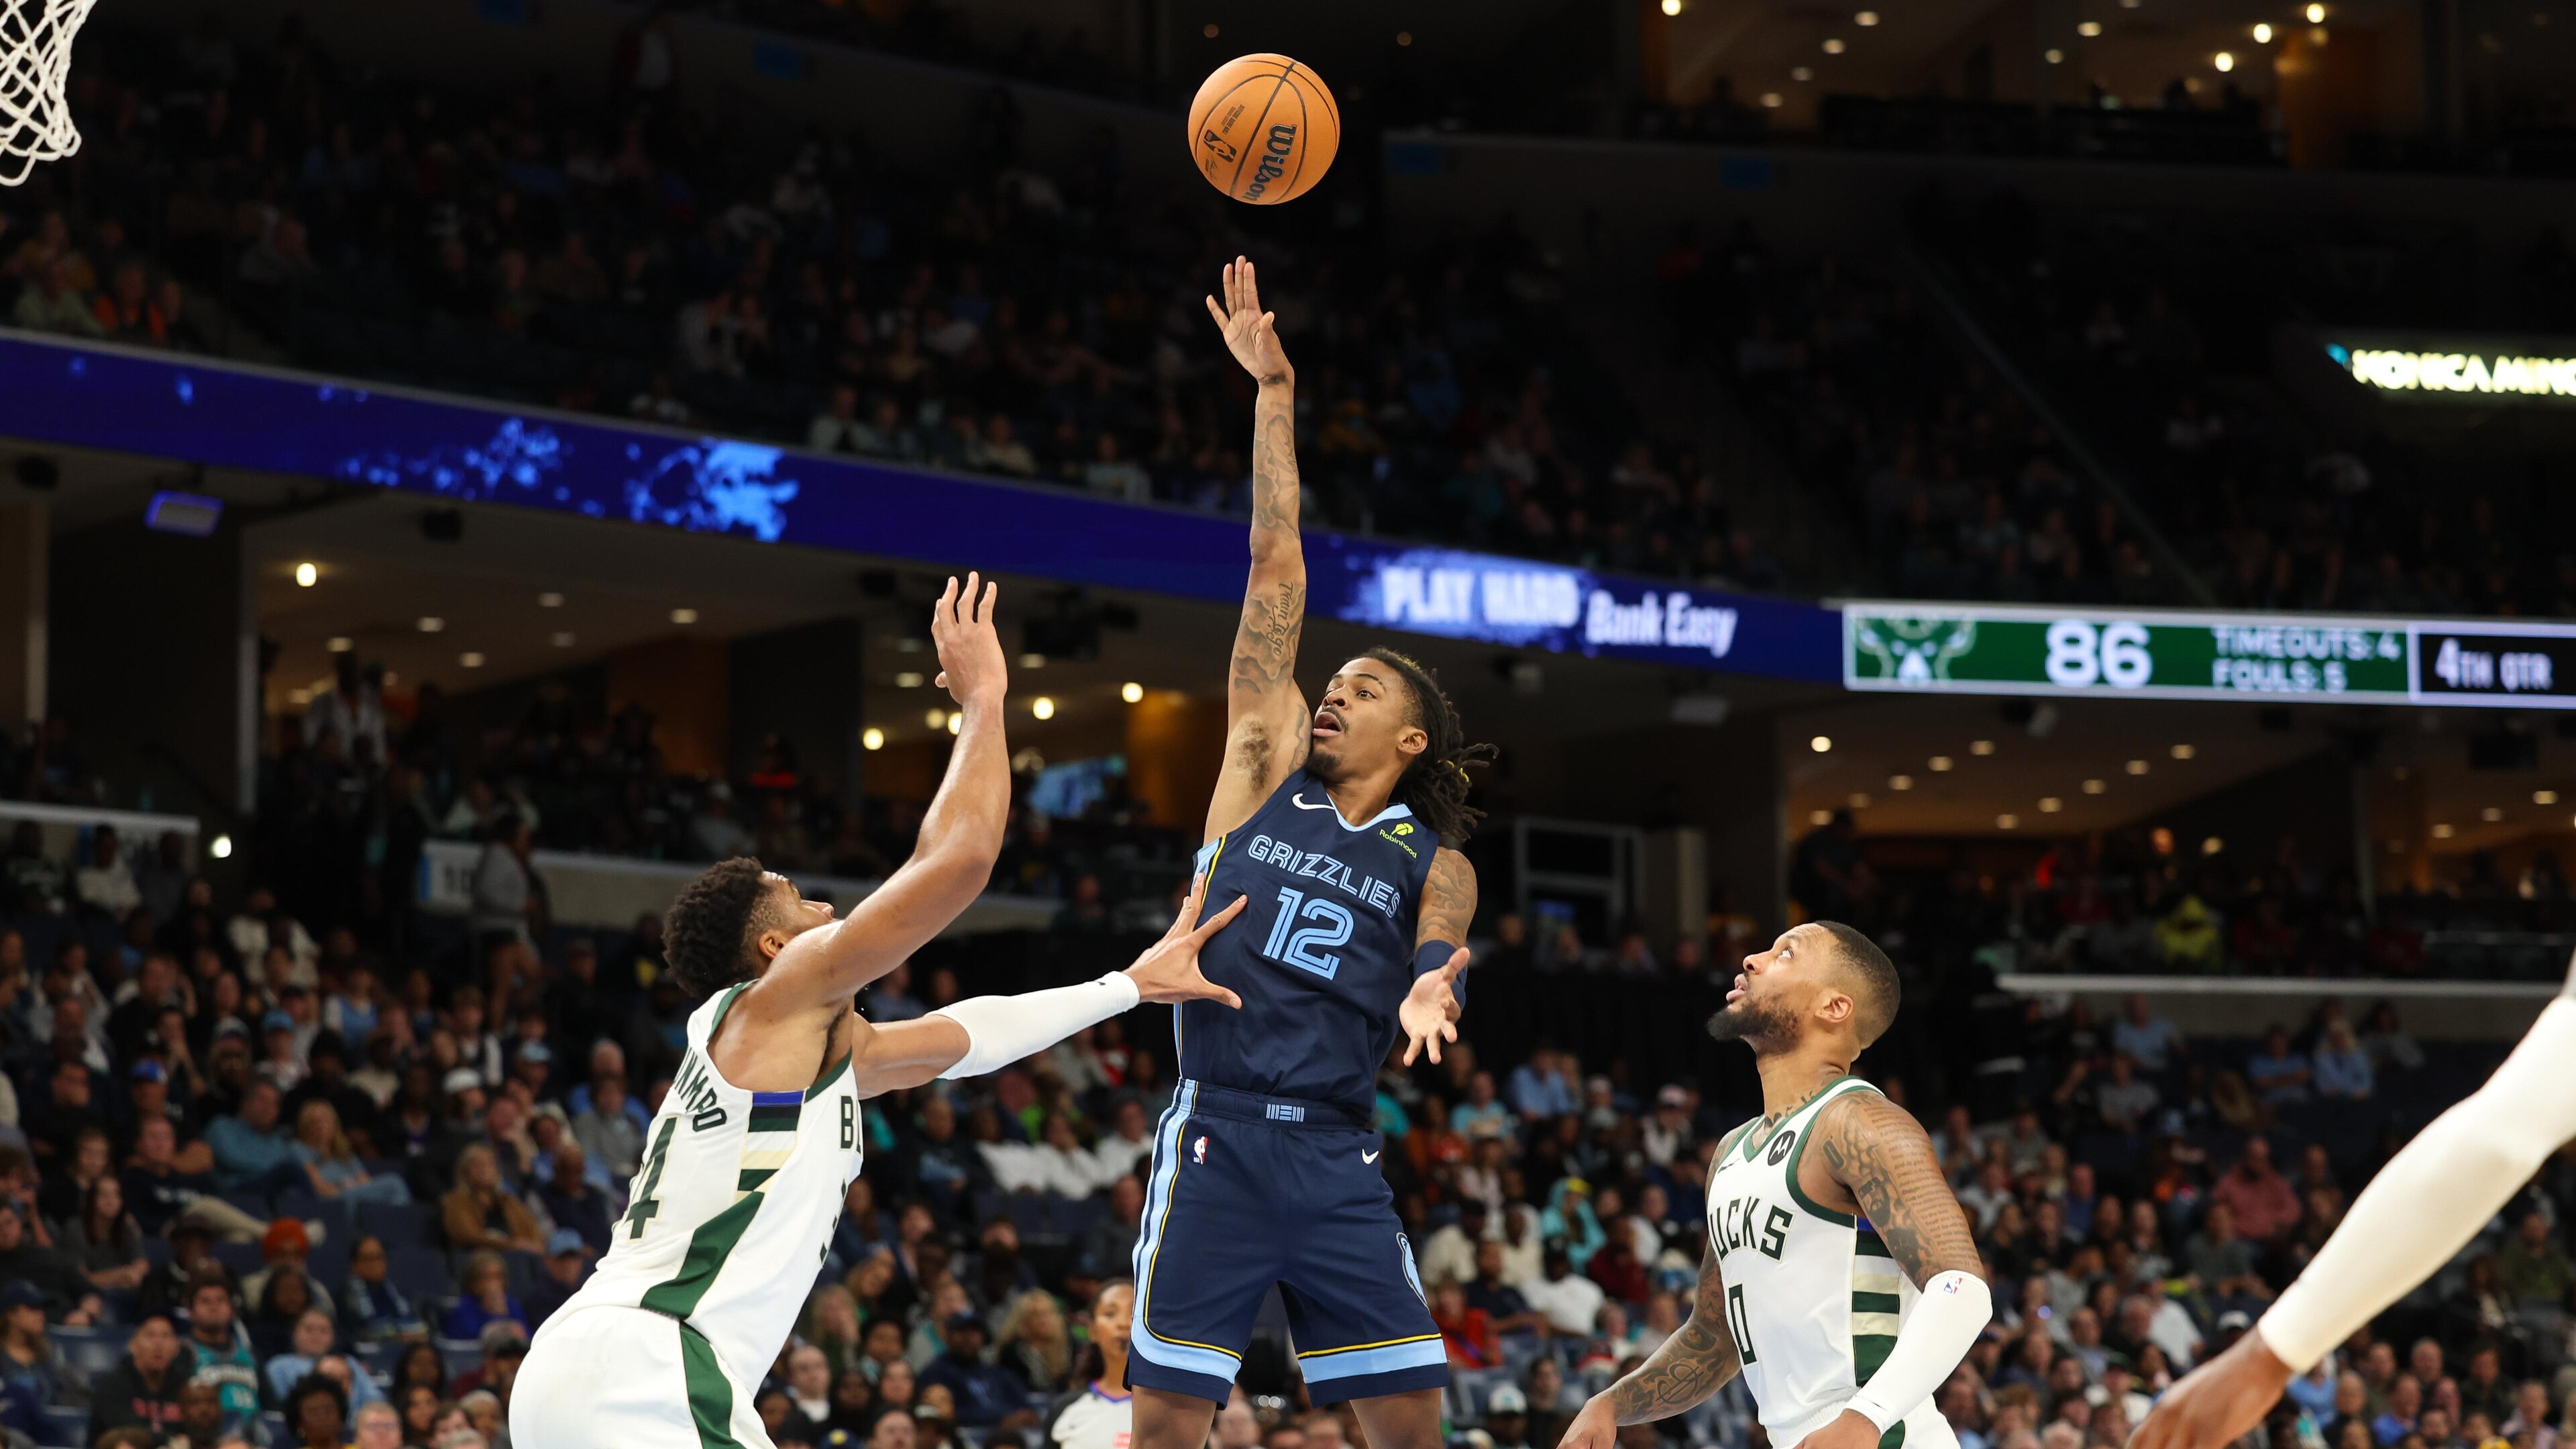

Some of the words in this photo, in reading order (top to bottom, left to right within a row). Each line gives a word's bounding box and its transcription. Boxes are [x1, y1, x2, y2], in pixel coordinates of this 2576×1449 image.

[1242, 123, 1297, 201] Wilson
[2352, 350, 2493, 393] KONICA
[1381, 566, 1475, 623] PLAY
[1481, 571, 1580, 628] HARD
[1585, 589, 1663, 645] Bank
[1664, 591, 1738, 658] Easy
[2377, 629, 2403, 662] 4
[2045, 620, 2153, 688] 86
[2323, 659, 2349, 694] 5
[2434, 637, 2494, 688] 4TH
[1248, 835, 1401, 918] GRIZZLIES
[1379, 828, 1417, 859] Robinhood
[1263, 885, 1354, 980] 12
[1729, 1283, 1757, 1365] 0
